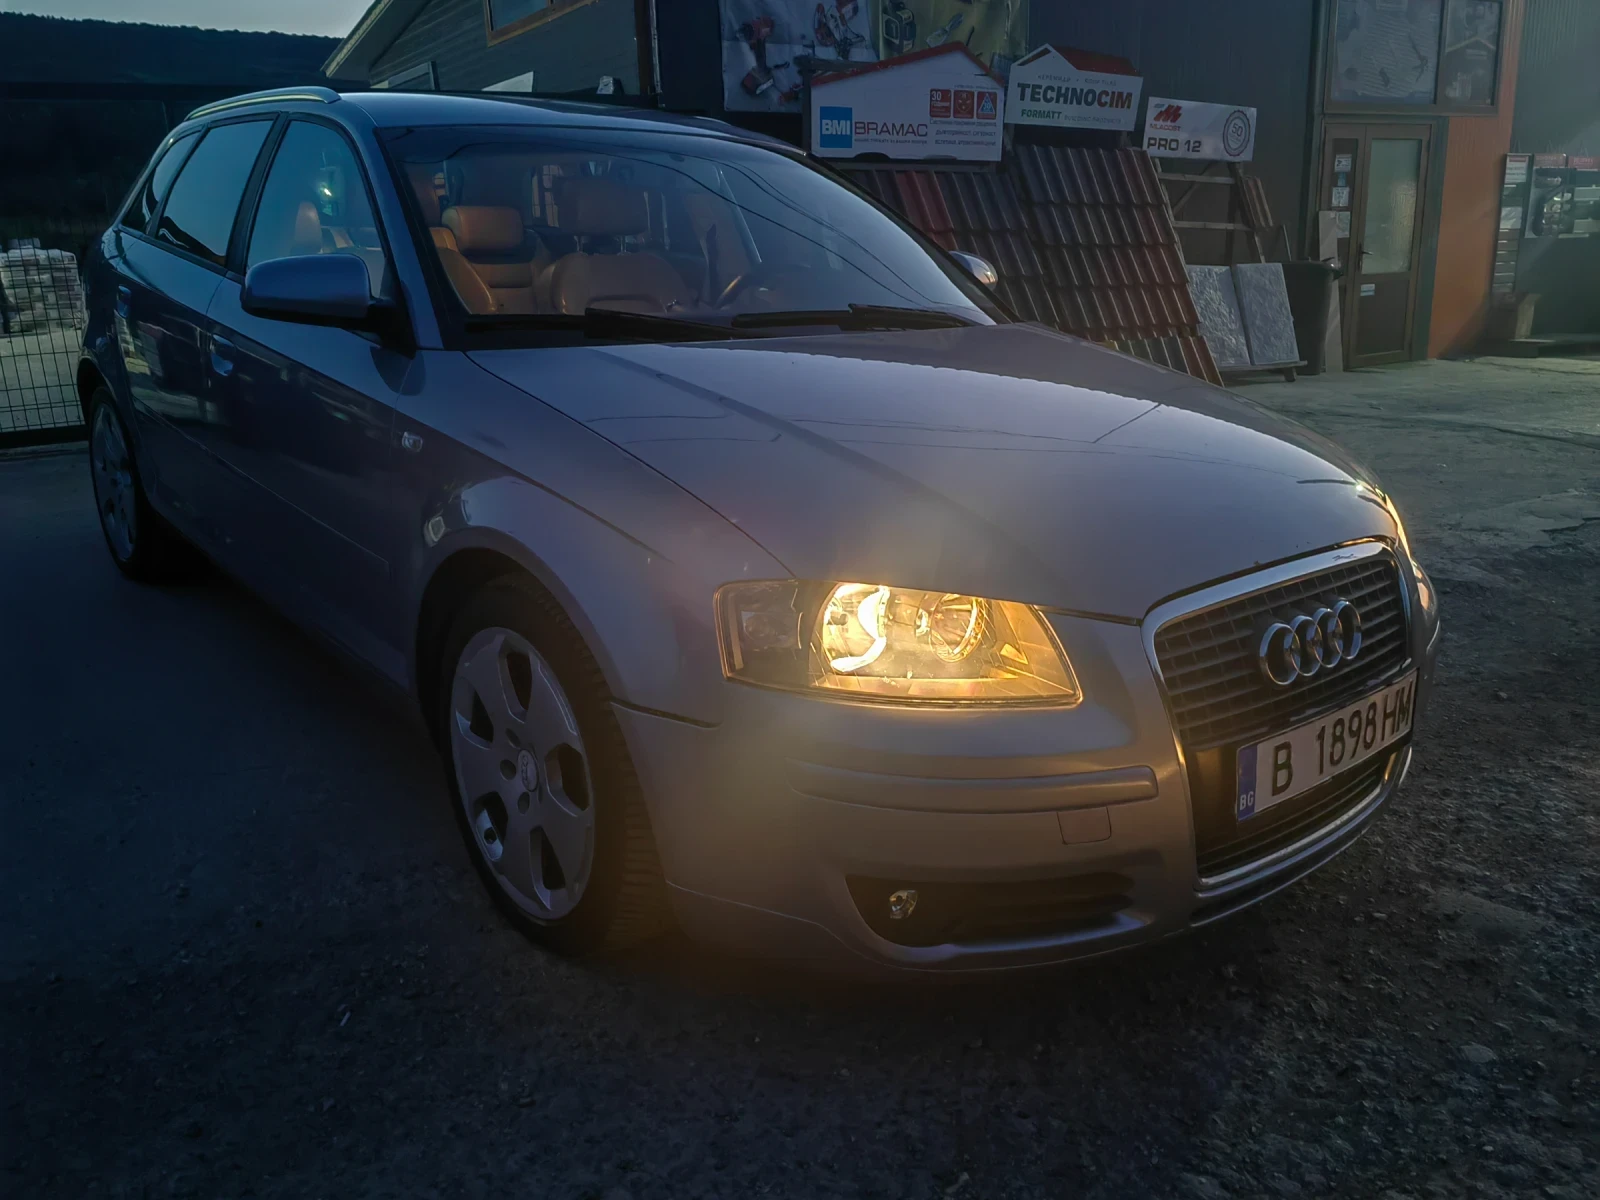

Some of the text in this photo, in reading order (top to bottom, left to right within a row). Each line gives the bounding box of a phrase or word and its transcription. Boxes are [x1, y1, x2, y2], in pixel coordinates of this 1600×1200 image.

[931, 91, 942, 101] 30
[1017, 82, 1133, 110] TECHNOCIM
[1020, 109, 1063, 120] FORMATT
[821, 119, 851, 135] BMI
[854, 121, 928, 137] BRAMAC
[1231, 123, 1244, 137] 50
[1147, 137, 1202, 153] PRO 12
[1271, 741, 1293, 797] B
[1239, 791, 1254, 811] BG
